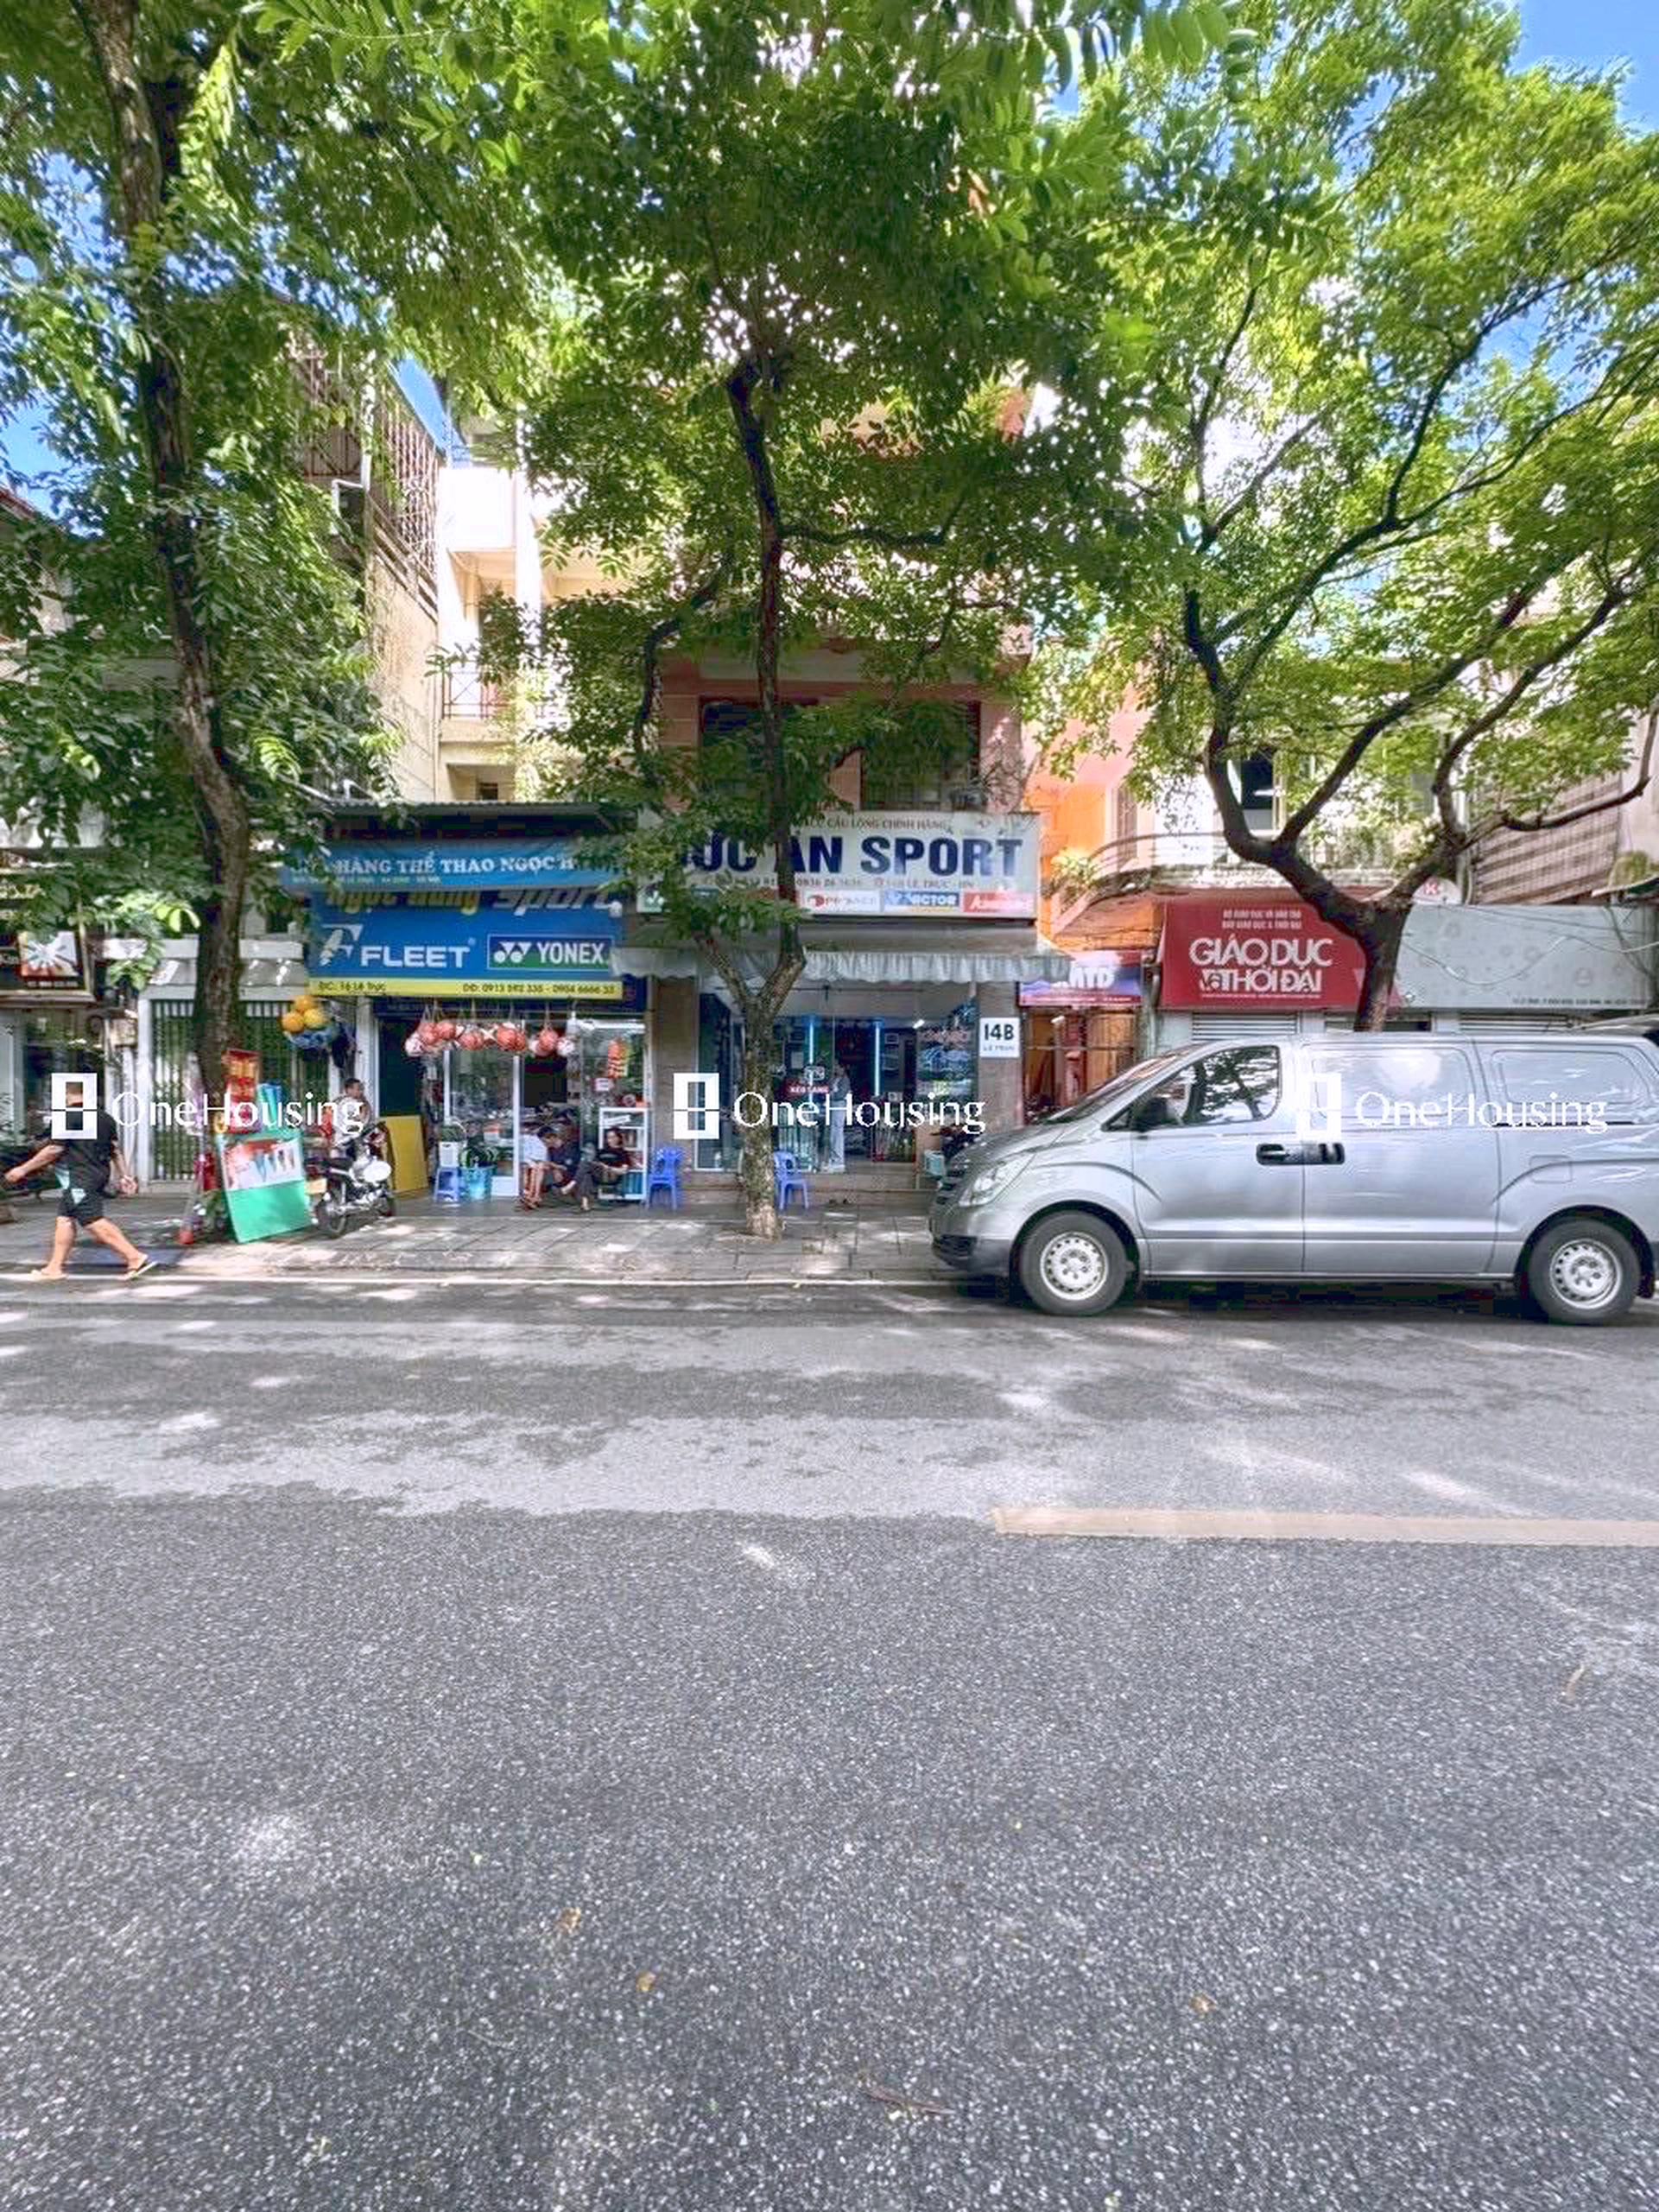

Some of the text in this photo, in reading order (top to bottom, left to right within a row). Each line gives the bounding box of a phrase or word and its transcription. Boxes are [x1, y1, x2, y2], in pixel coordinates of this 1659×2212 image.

[440, 857, 495, 874] THAO
[500, 855, 554, 875] NGỌC
[860, 834, 1023, 876] SPORT
[360, 945, 471, 968] FLEET
[536, 941, 605, 965] YONEX
[1189, 933, 1333, 969] GIÁO DỤC
[985, 1023, 1014, 1041] 14B
